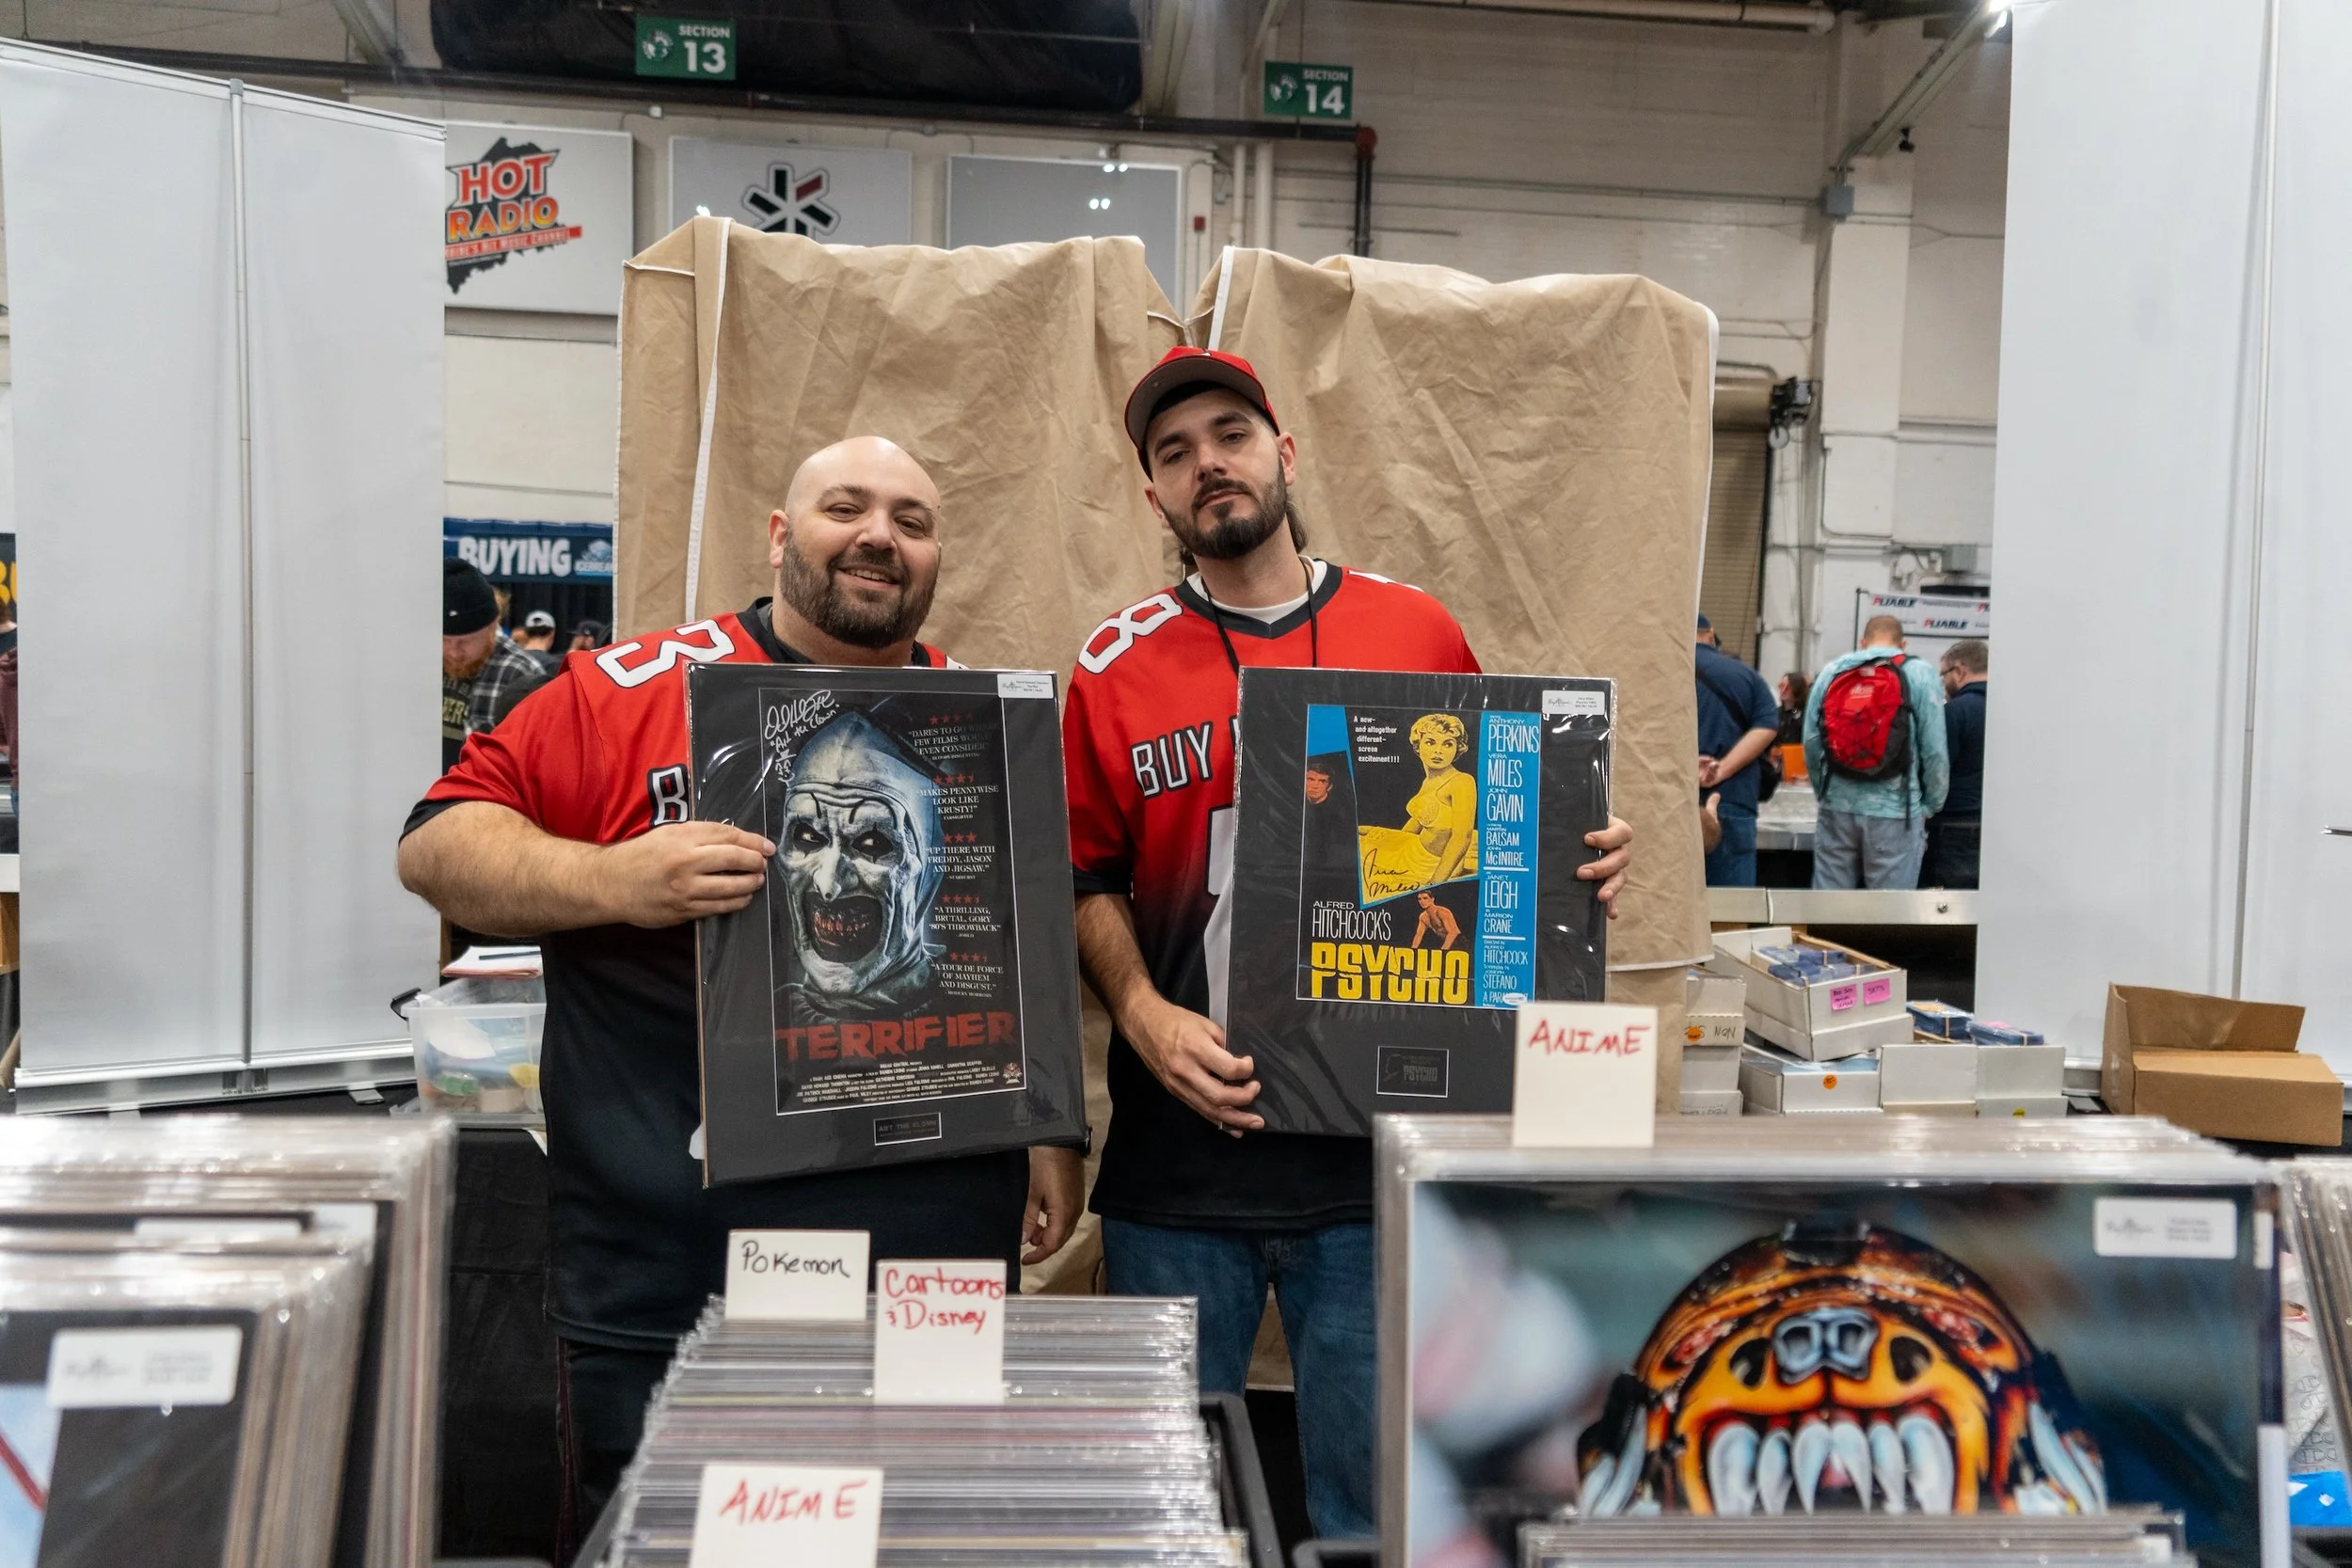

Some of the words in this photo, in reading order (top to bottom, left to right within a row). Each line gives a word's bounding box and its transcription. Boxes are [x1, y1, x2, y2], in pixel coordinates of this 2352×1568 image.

[678, 24, 730, 38] SECTION
[683, 40, 726, 73] 13
[1302, 69, 1348, 82] SECTION
[1305, 83, 1345, 115] 14
[455, 152, 555, 206] HOT
[447, 196, 559, 243] RADIO
[458, 536, 572, 577] BUYING
[914, 738, 930, 747] FEW
[932, 736, 960, 745] FILMS
[1367, 725, 1397, 735] altogether
[1487, 724, 1539, 753] PERKINS
[919, 747, 941, 755] EVEN
[1131, 721, 1213, 799] BUY
[1487, 759, 1522, 788] MILES
[932, 797, 956, 805] LOOK
[950, 785, 999, 795] PENNYWISE
[1486, 793, 1523, 823] GAVIN
[942, 846, 971, 854] THERE
[1486, 832, 1519, 847] BALSAM
[928, 855, 962, 863] FREDDY,
[1486, 850, 1524, 867] McINTIRE
[1312, 901, 1355, 910] ALFRED
[1485, 880, 1518, 910] LEIGH
[1311, 909, 1391, 942] HITCHCOCK'S
[1484, 918, 1513, 934] CRANE
[1483, 949, 1528, 965] HITCHCOCK
[956, 974, 990, 982] MAYHEM
[1311, 942, 1470, 1005] PSYCHO
[1483, 974, 1518, 990] STEFANO
[1483, 991, 1487, 1003] A
[775, 1011, 1018, 1062] TERRIFIER
[1528, 1019, 1651, 1058] ANIME
[1403, 1065, 1438, 1082] PSYCHO
[742, 1240, 850, 1278] Pokemon
[884, 1267, 1005, 1301] Cartoons
[897, 1299, 986, 1335] Disney
[719, 1477, 868, 1525] ANIME
